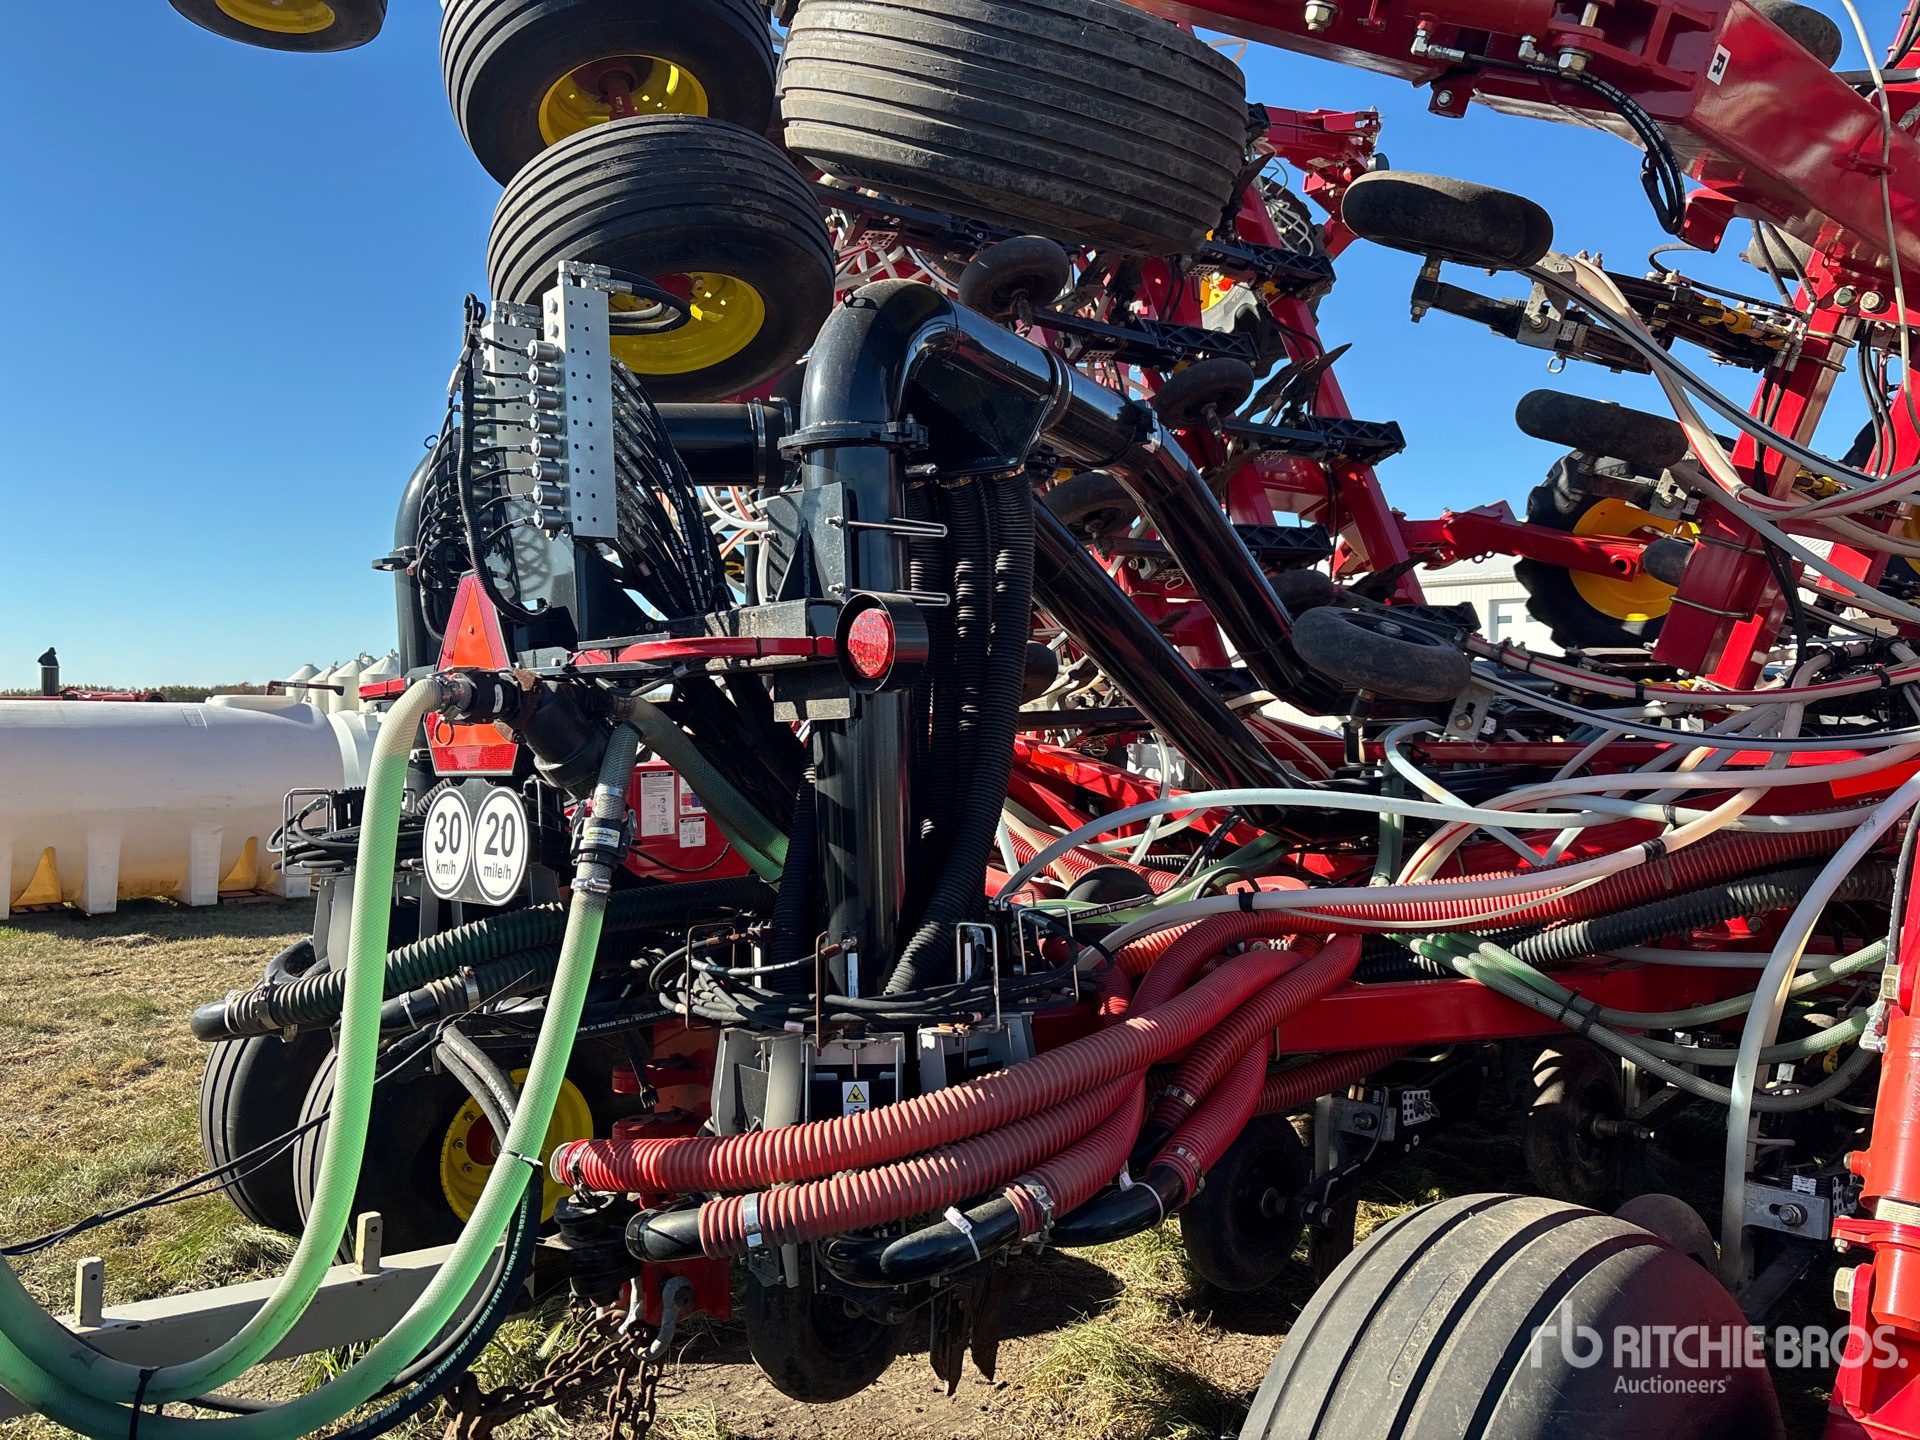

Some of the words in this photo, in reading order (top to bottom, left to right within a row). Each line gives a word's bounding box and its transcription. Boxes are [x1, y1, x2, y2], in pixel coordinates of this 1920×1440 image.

[1712, 52, 1726, 75] R
[435, 812, 462, 854] 30
[484, 812, 515, 857] 20
[436, 860, 456, 875] km/h
[483, 863, 512, 880] mile/h
[490, 1287, 503, 1305] SAE
[436, 1352, 458, 1375] MSHA
